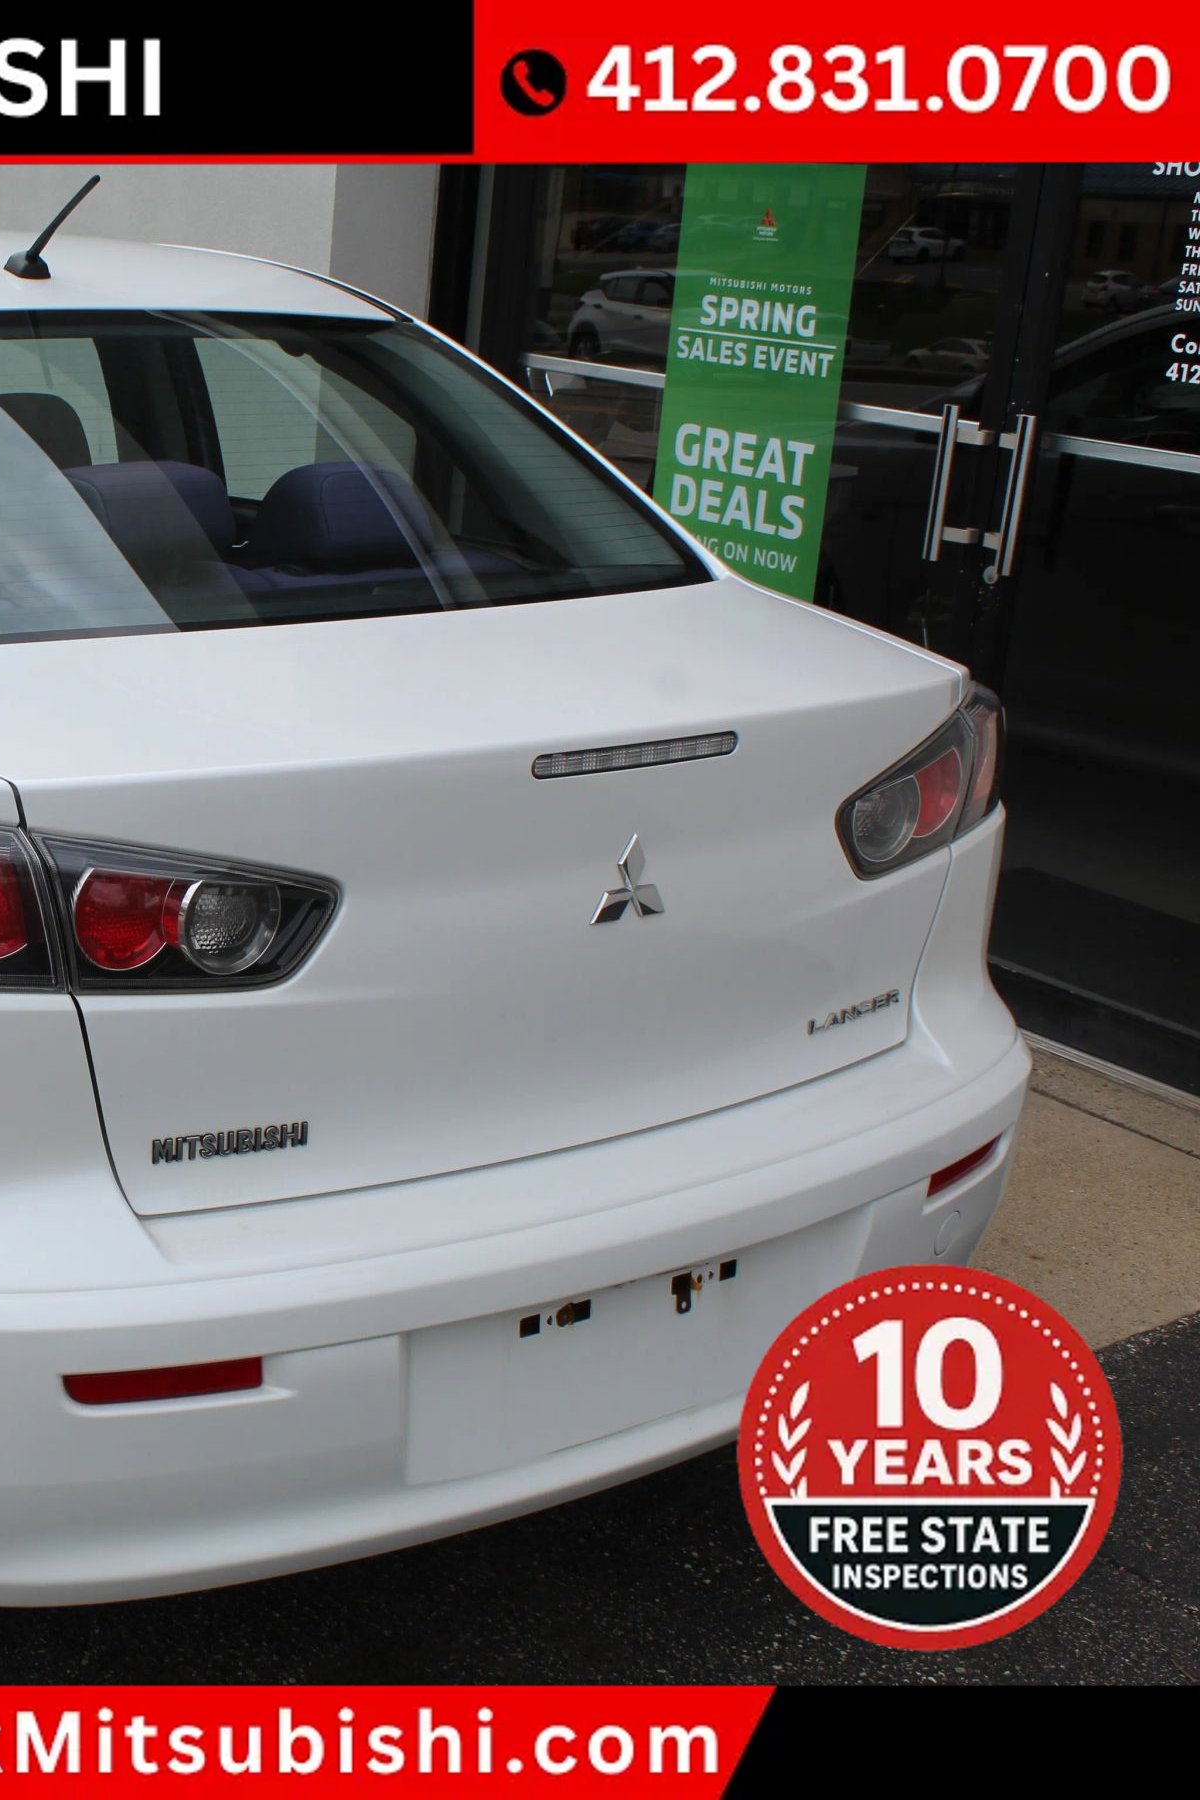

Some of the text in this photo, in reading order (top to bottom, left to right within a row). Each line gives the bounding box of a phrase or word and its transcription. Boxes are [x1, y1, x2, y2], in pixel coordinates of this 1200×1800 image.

[709, 277, 813, 296] MITSUBISHI MOTORS
[700, 294, 818, 338] SPRING
[676, 335, 835, 379] SALES EVENT
[674, 423, 816, 487] GREAT
[669, 473, 806, 541] DEALS
[723, 541, 749, 563] ON
[753, 547, 798, 573] NOW
[807, 988, 900, 1036] LANCER
[151, 1120, 309, 1165] MITSUBISHI
